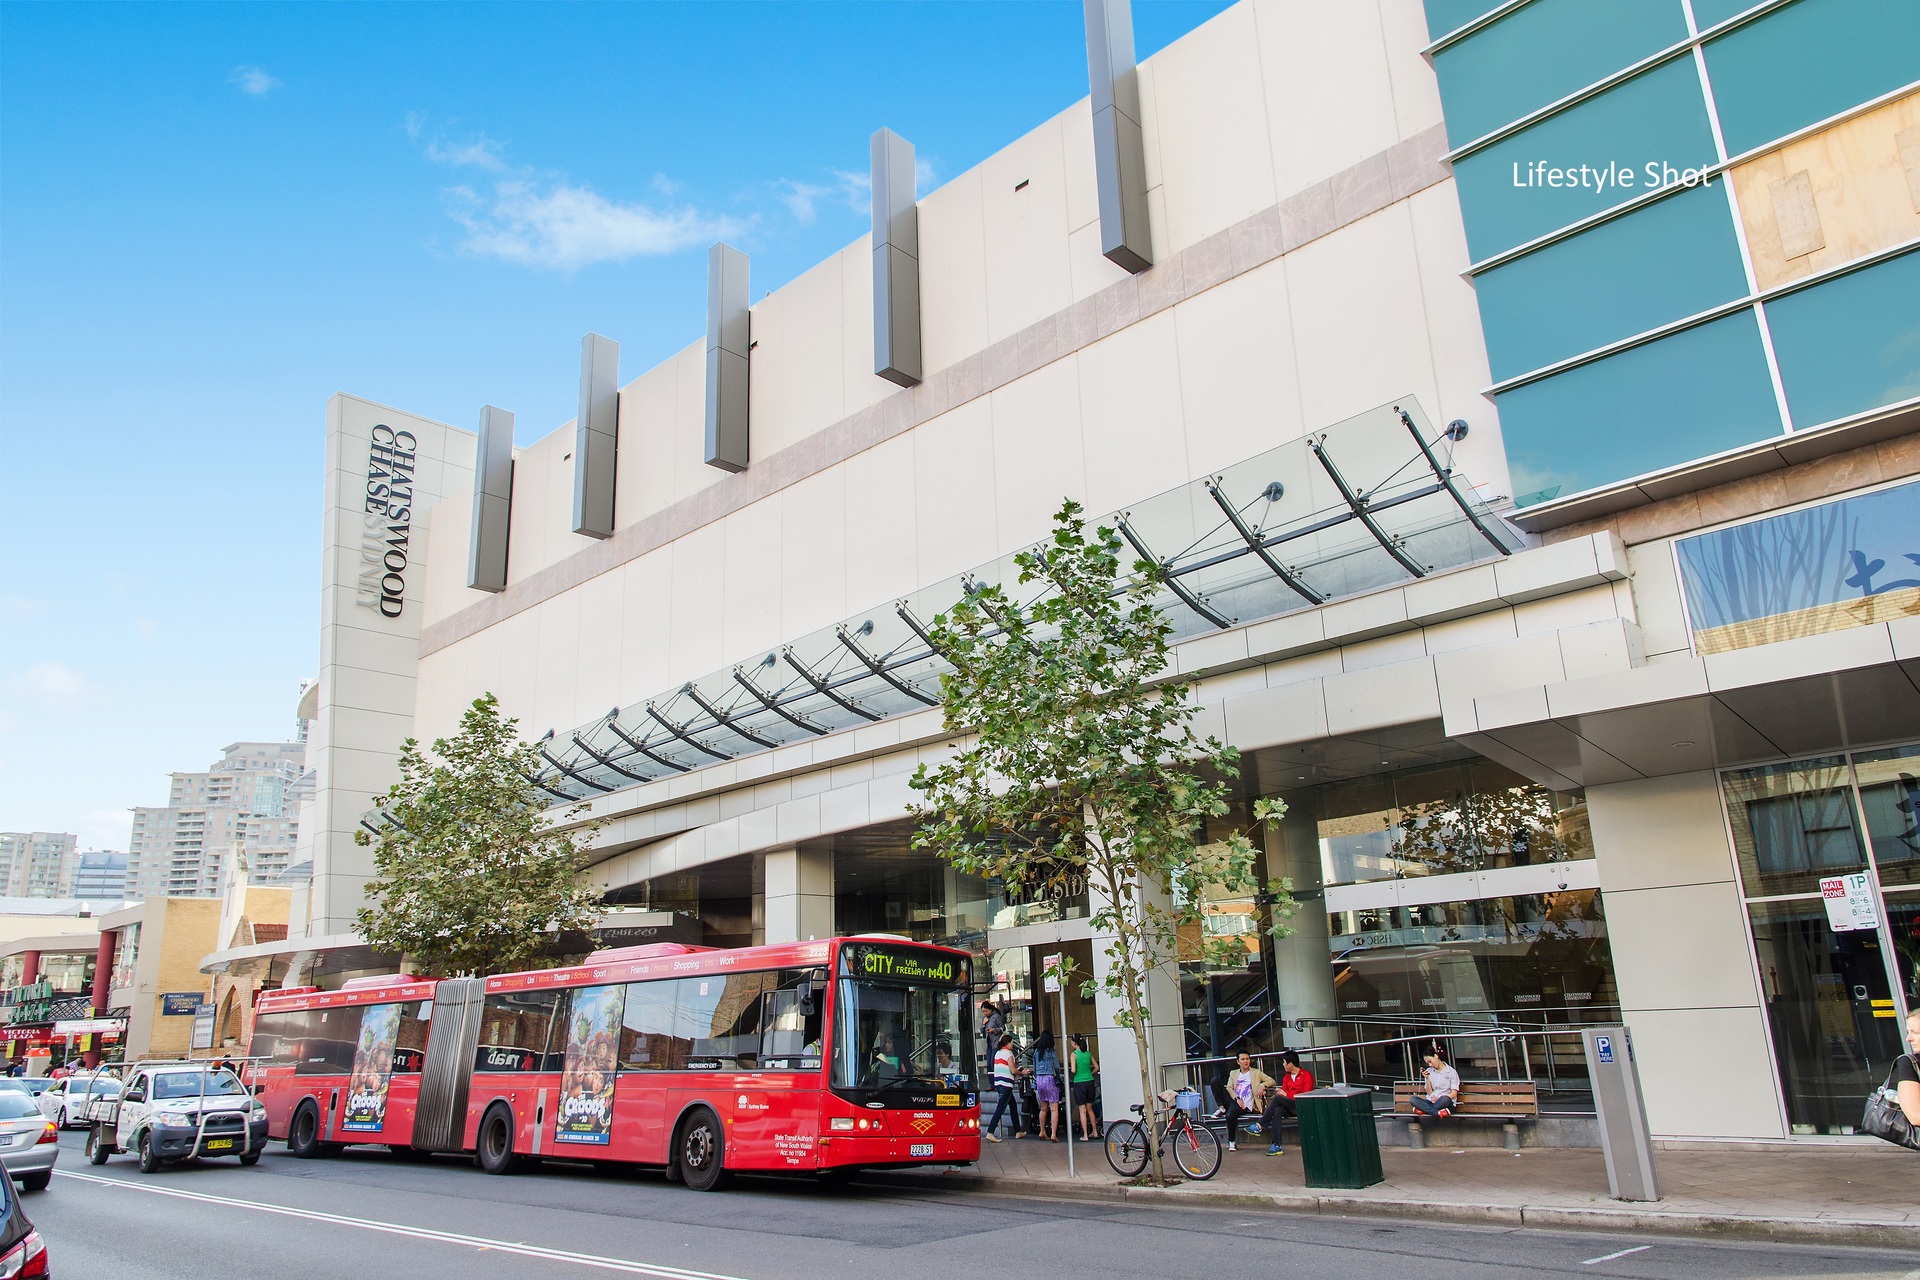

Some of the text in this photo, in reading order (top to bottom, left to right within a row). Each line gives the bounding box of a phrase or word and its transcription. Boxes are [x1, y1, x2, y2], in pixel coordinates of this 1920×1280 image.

[356, 424, 395, 615] CHASE SYDNEY
[380, 430, 418, 618] CHATSWOOD
[1822, 881, 1843, 890] MAIL
[1850, 875, 1866, 889] 1P
[1824, 890, 1845, 898] ZONE
[809, 947, 828, 958] 2228
[864, 953, 893, 974] CITY
[905, 959, 917, 967] VIA
[490, 980, 502, 988] Home
[574, 971, 589, 979] School
[593, 969, 607, 979] Sport
[630, 965, 649, 974] Friends
[673, 960, 699, 971] Shopping
[719, 957, 735, 965] Work
[896, 962, 952, 980] FREEWAY M40
[565, 1096, 606, 1119] CROODS
[797, 1135, 814, 1143] Authority
[786, 1157, 799, 1165] Tempe
